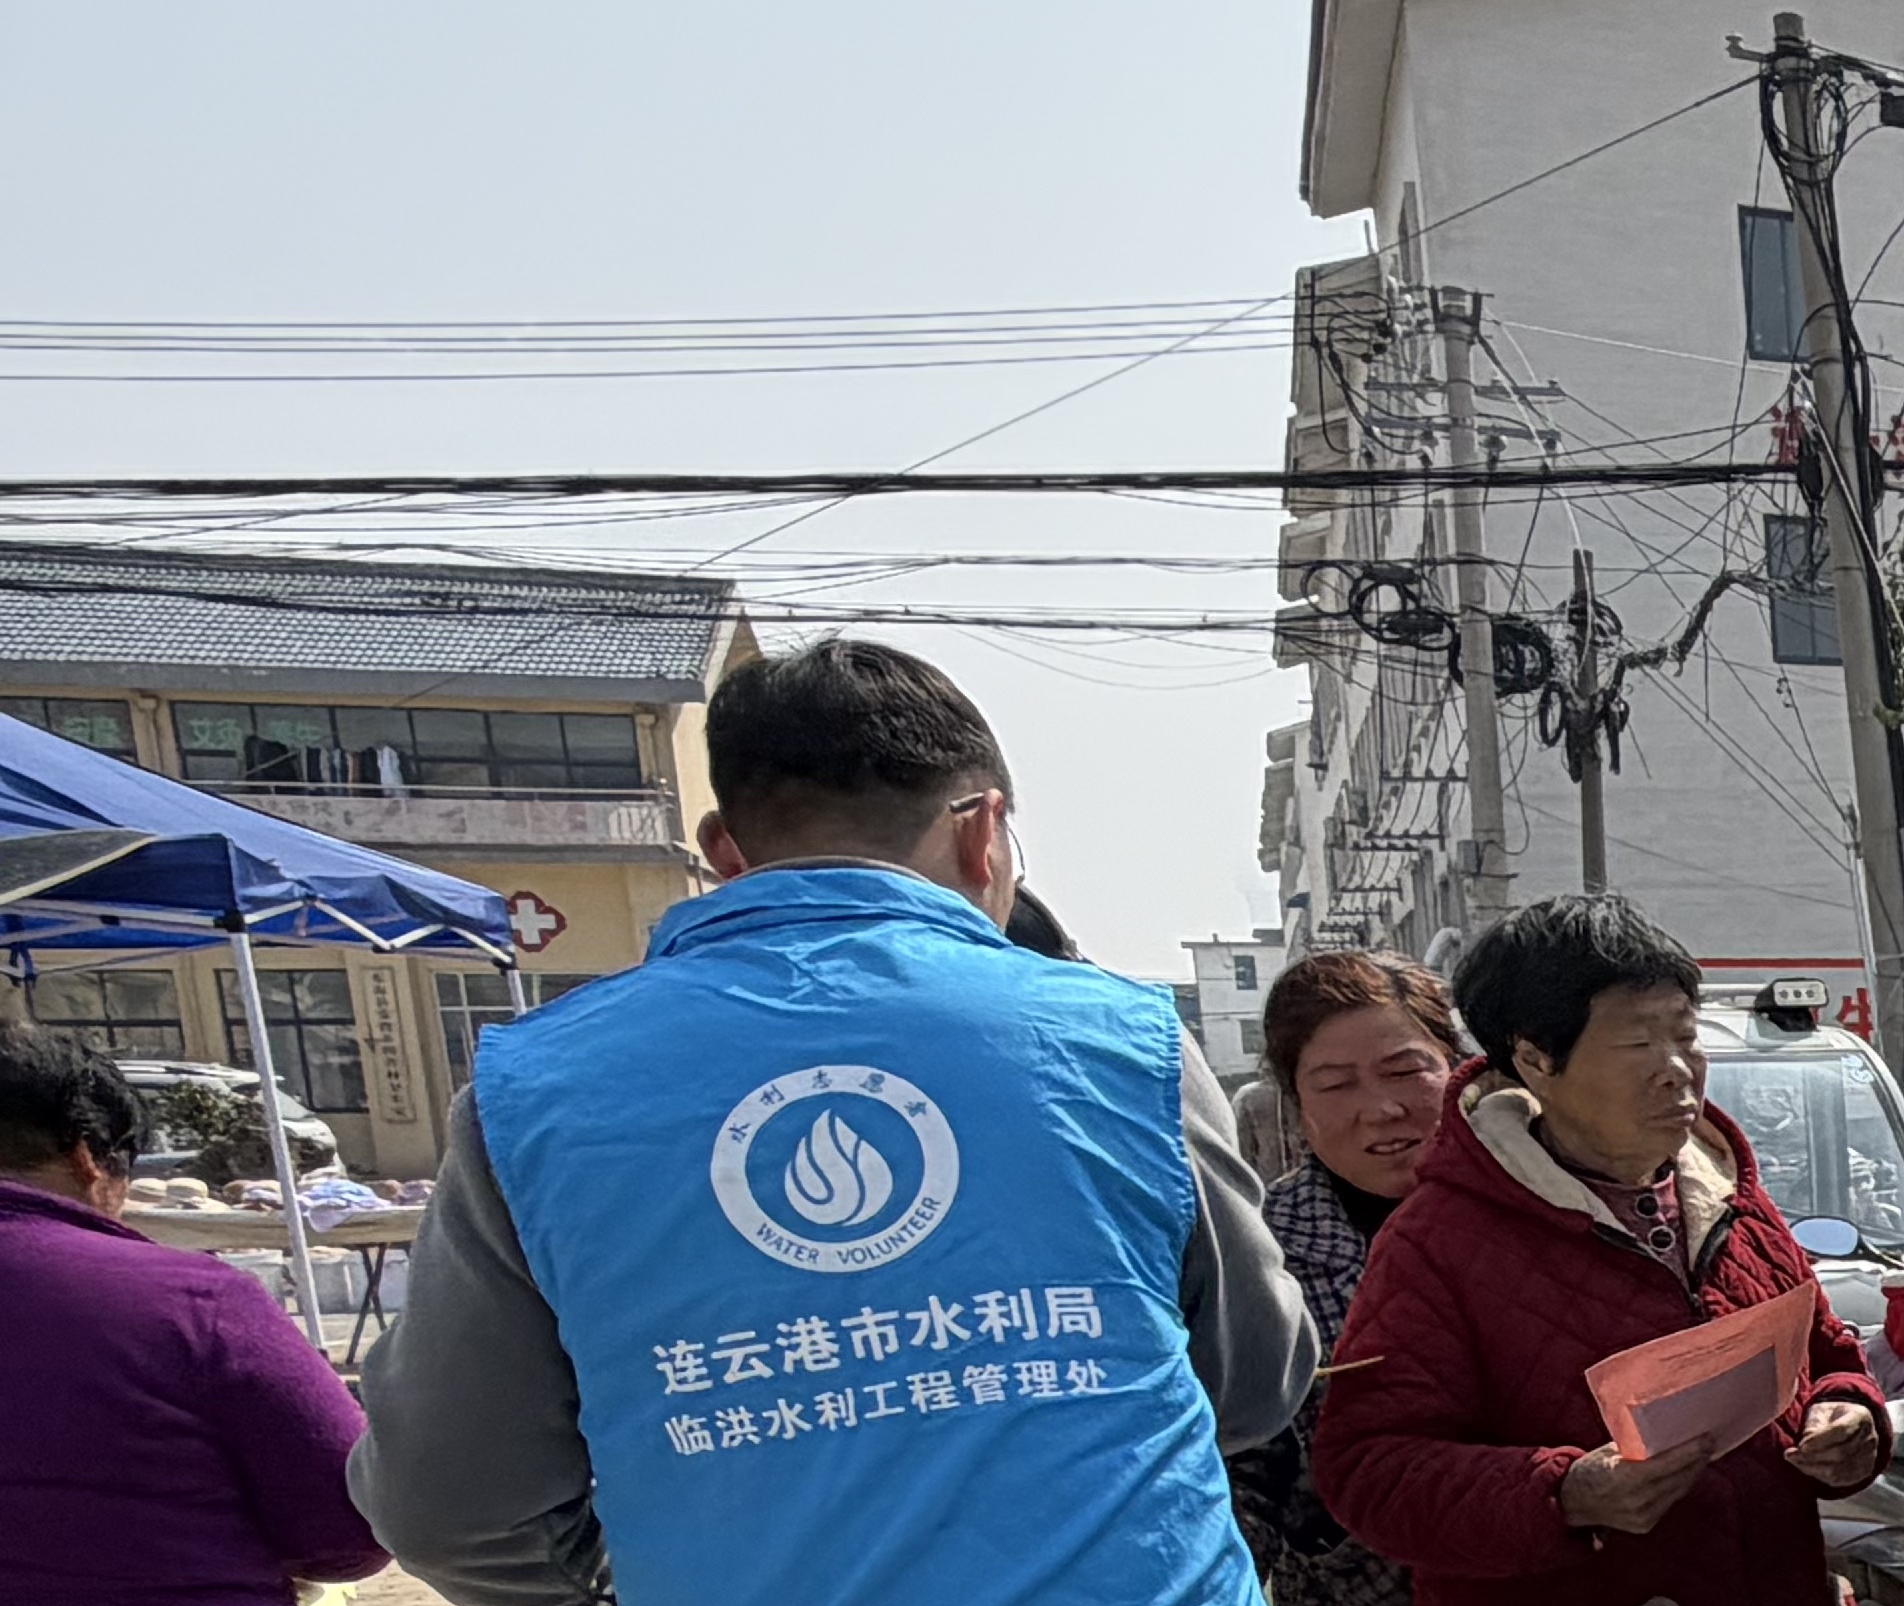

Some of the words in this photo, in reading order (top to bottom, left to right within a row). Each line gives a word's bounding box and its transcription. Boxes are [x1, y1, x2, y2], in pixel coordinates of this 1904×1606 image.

[756, 1221, 820, 1266] WATER
[836, 1195, 942, 1267] VOLUNTEER
[652, 1285, 1104, 1396] 连云港市水利局
[664, 1358, 1109, 1457] 临洪水利工程管理处
